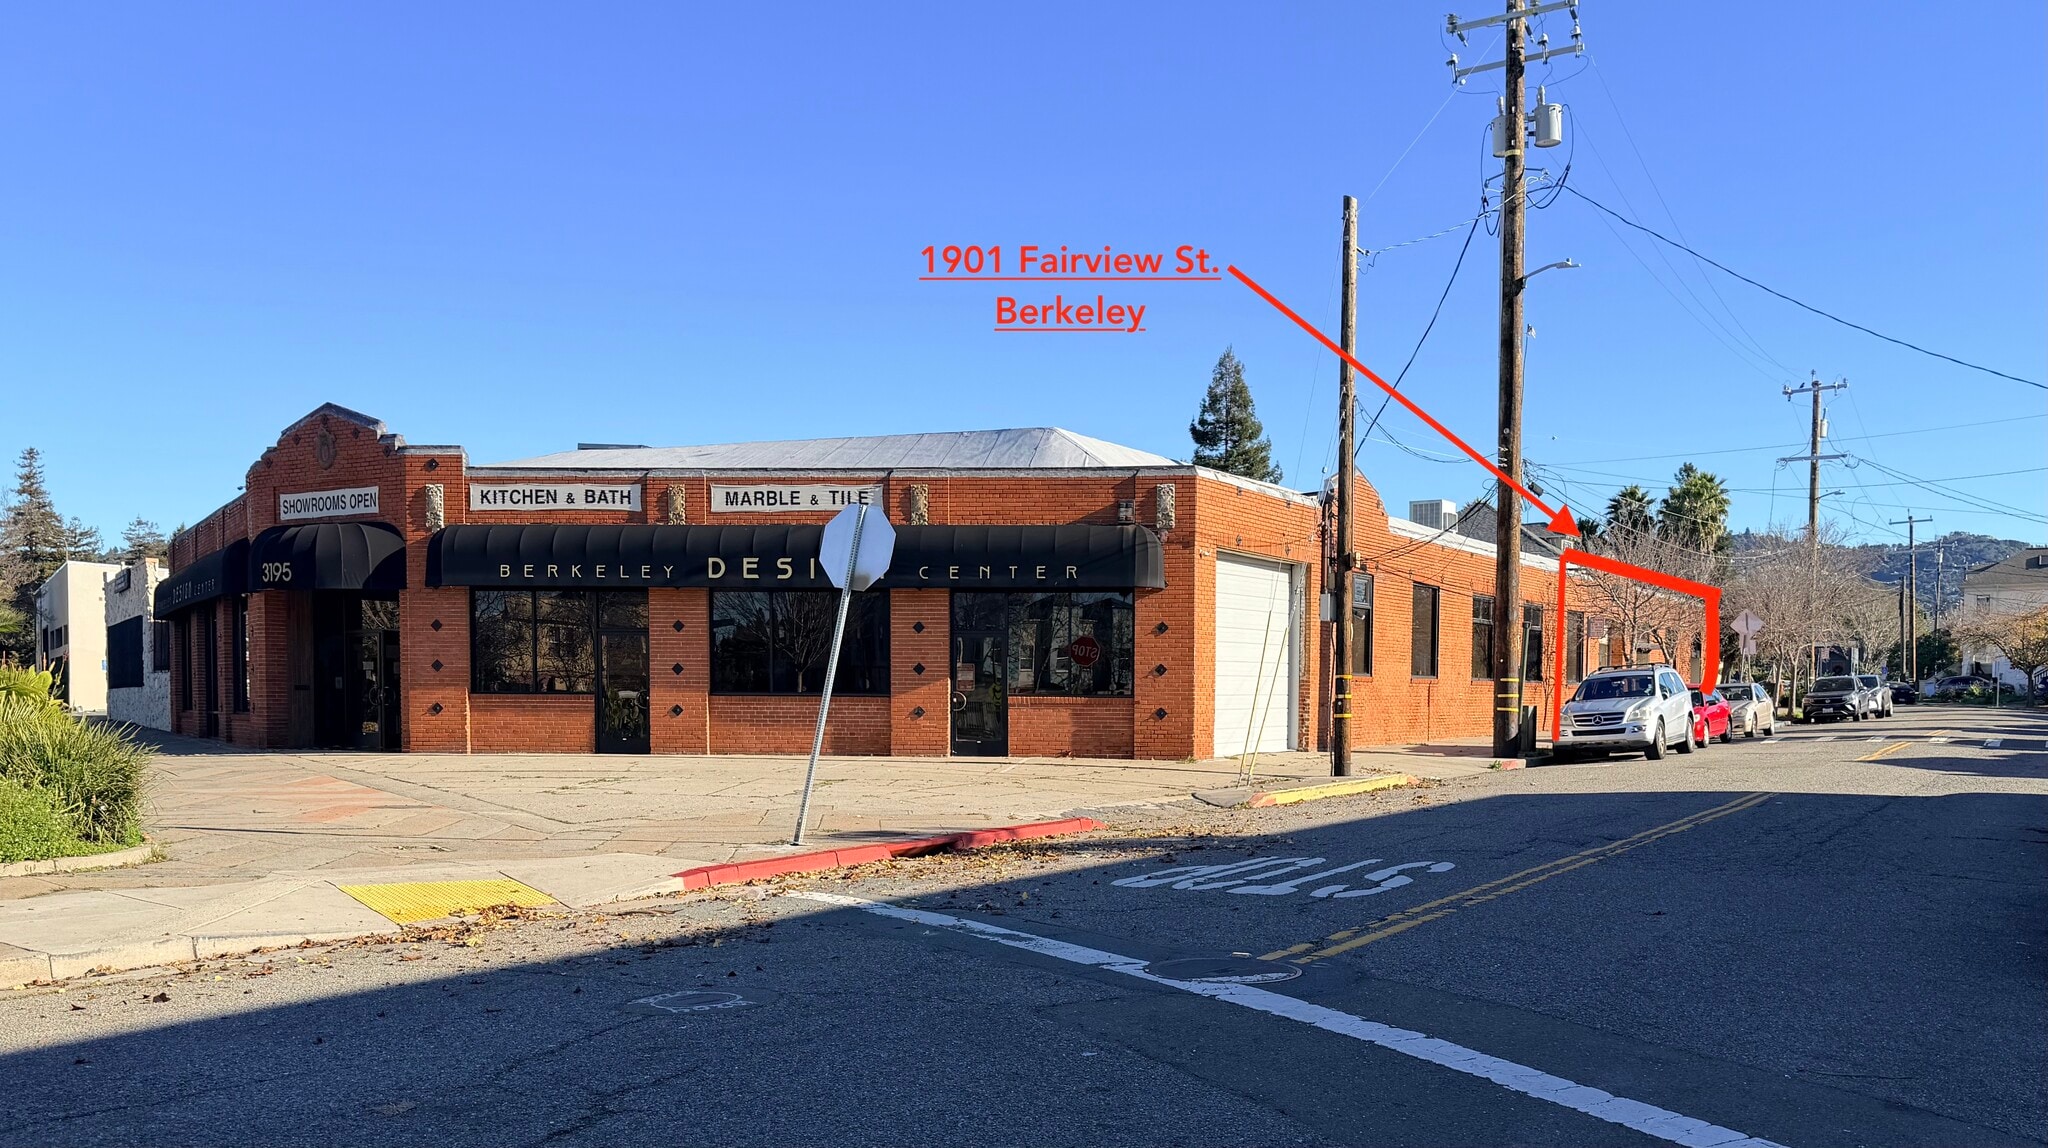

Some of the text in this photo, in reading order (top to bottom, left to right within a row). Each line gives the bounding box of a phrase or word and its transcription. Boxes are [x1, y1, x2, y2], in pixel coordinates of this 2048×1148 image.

[282, 492, 377, 515] SHOWROOMS OPEN
[480, 489, 632, 505] KITCHEN & BATH
[725, 490, 870, 506] MARBLE & TILE
[262, 562, 292, 582] 3195
[500, 557, 1077, 580] BERKELEY DESI CENTER
